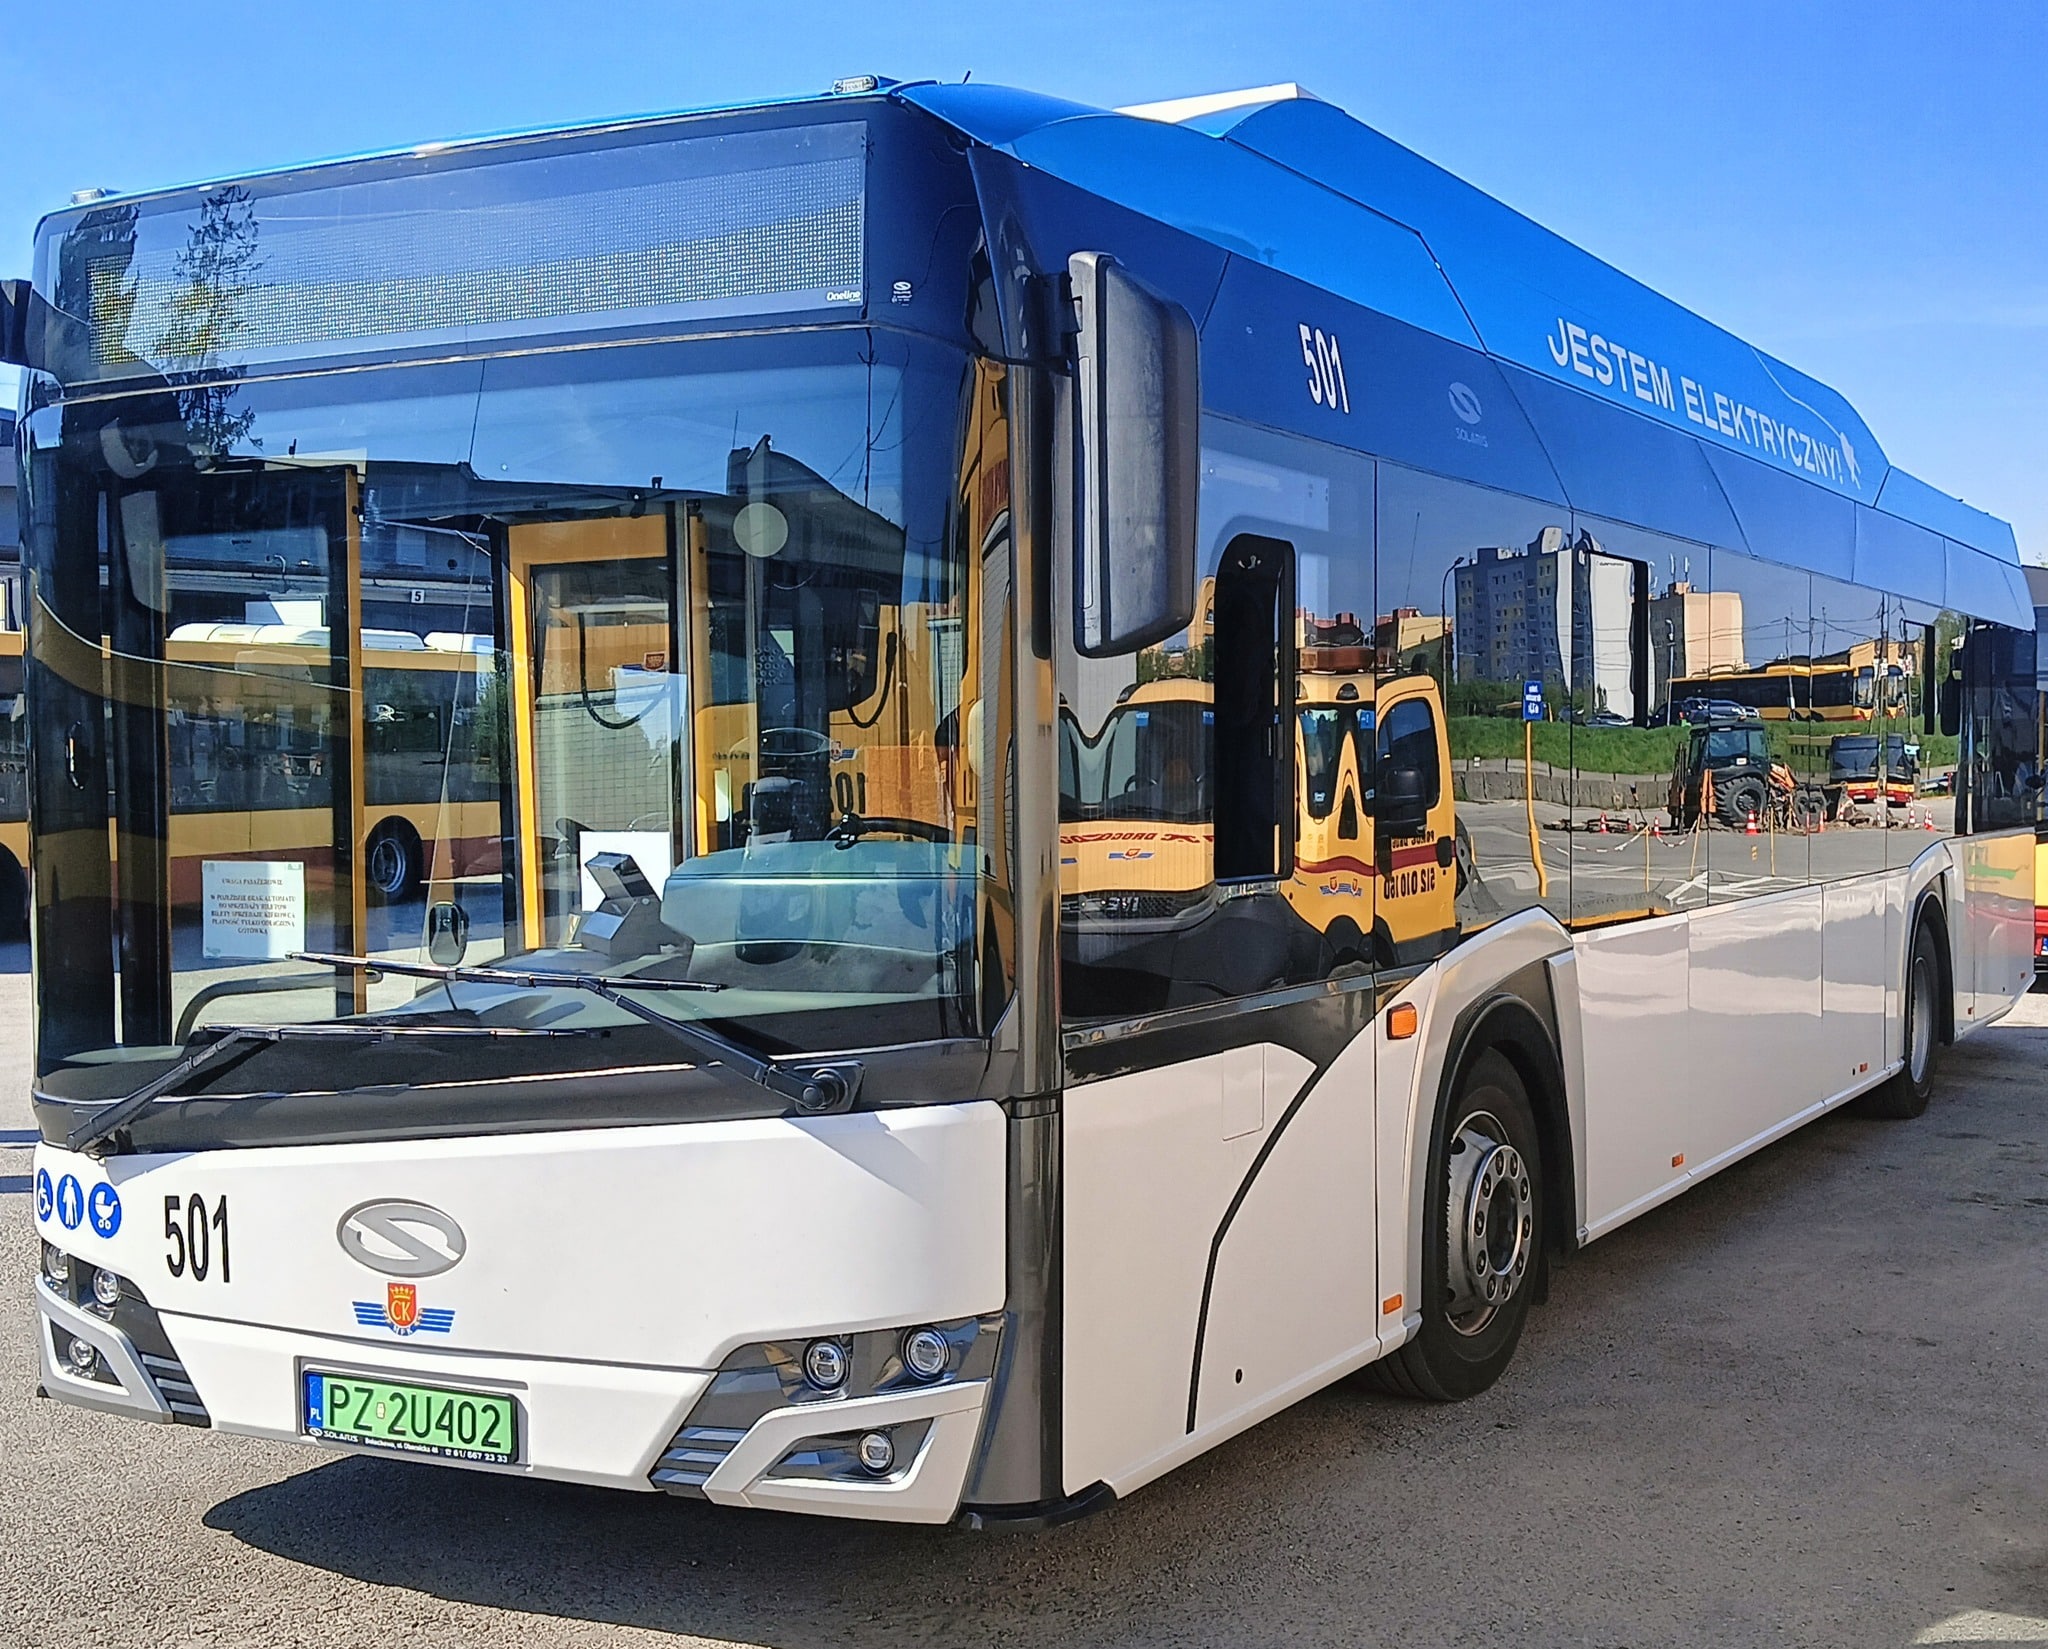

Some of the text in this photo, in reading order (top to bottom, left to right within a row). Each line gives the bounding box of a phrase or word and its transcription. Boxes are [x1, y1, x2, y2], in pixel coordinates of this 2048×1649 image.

[1299, 322, 1349, 414] 501
[1547, 317, 1844, 485] JESTEM ELEKTRYCZNY!
[414, 591, 422, 602] 5
[164, 1193, 230, 1283] 501
[391, 1300, 411, 1321] CK
[310, 1407, 322, 1421] PL
[329, 1383, 502, 1449] PZ 2U402
